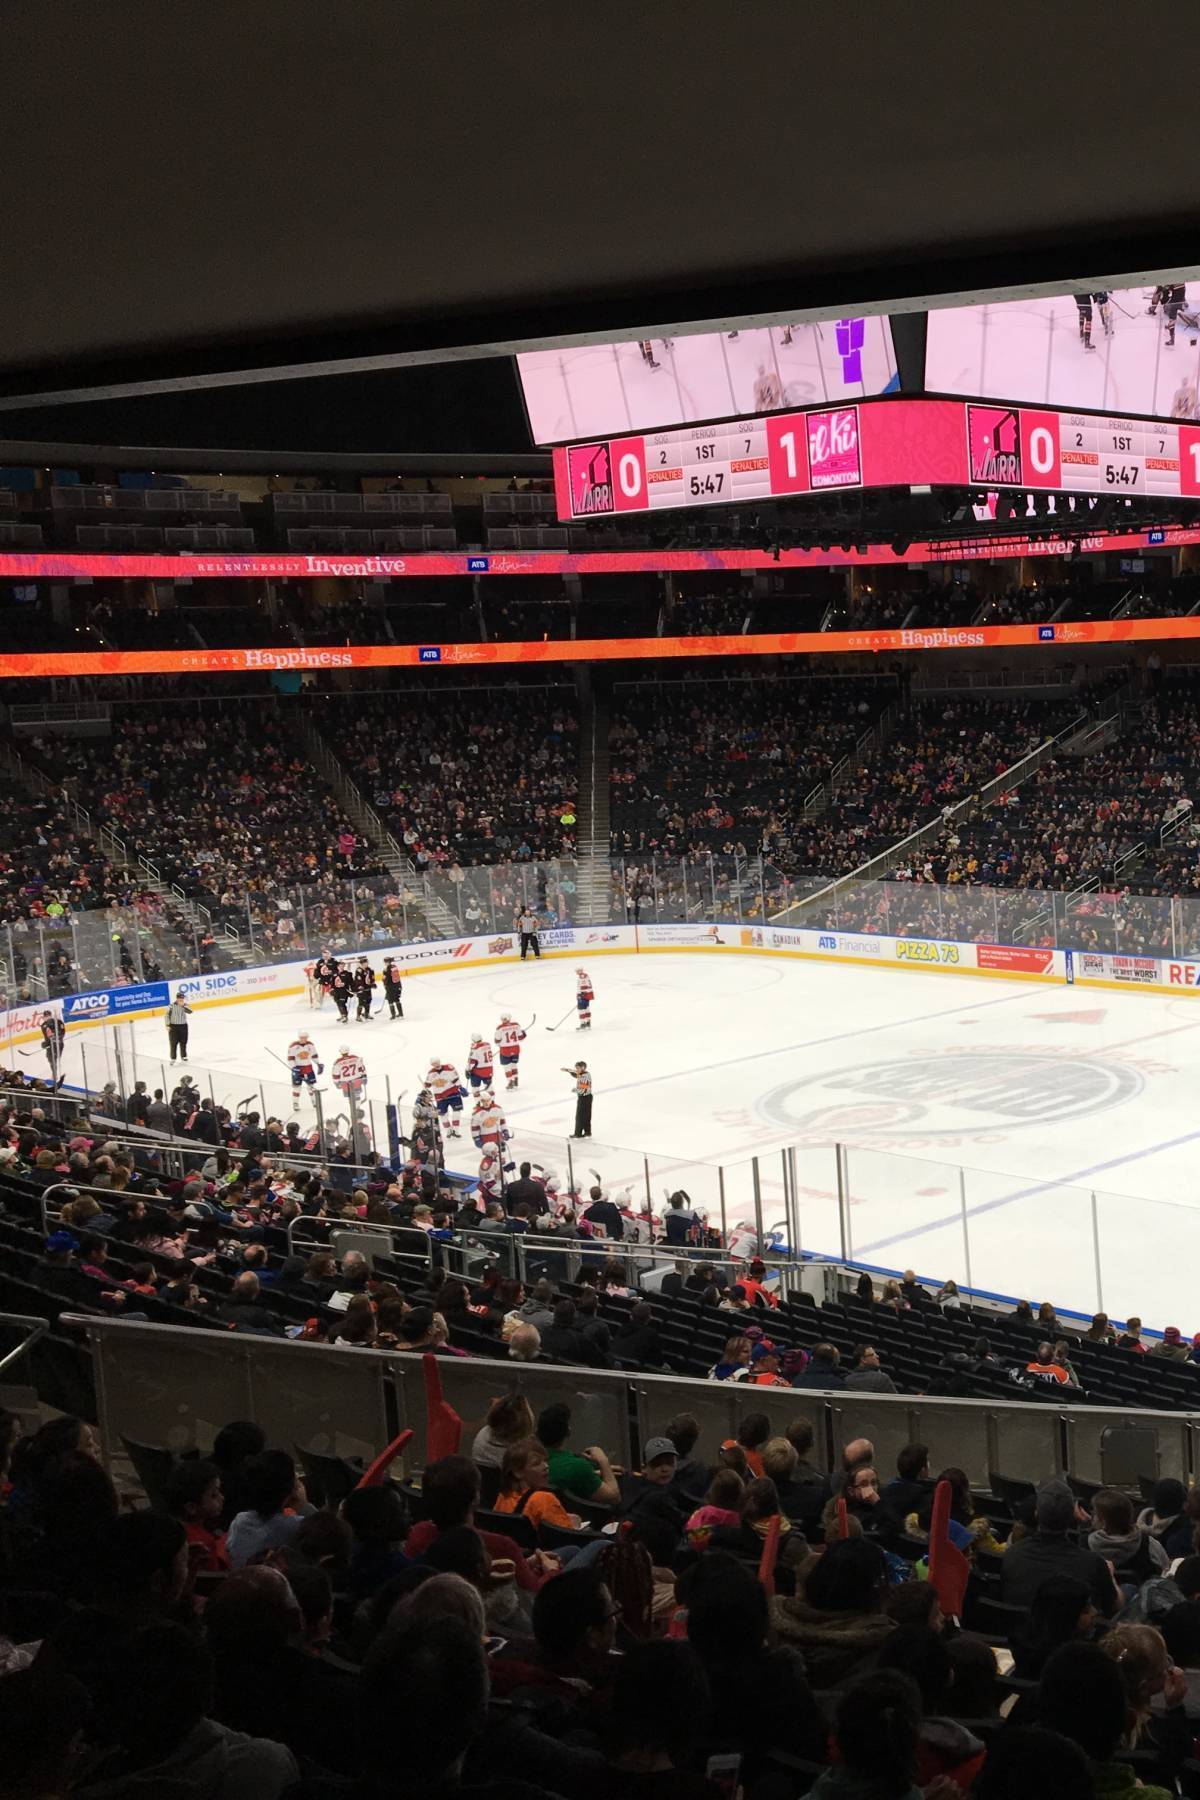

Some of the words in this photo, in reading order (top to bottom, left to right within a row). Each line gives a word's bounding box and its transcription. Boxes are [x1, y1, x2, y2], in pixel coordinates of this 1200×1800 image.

[739, 423, 754, 433] SOG
[1070, 417, 1085, 427] SOG
[654, 434, 668, 445] SOG
[744, 439, 751, 454] 7
[1076, 433, 1083, 447] 2
[1112, 436, 1132, 451] 1ST
[695, 444, 716, 460] 1ST
[1030, 427, 1055, 474] 0
[1159, 440, 1165, 454] 7
[660, 451, 667, 465] 2
[780, 431, 797, 478] 1
[1062, 453, 1098, 465] PENALTIES
[731, 458, 768, 473] PENALTIES
[1146, 458, 1179, 471] PENALTIES
[619, 453, 642, 497] 0
[648, 469, 683, 483] PENALTIES
[811, 471, 859, 487] EDMONTON
[1105, 465, 1139, 486] 5:47
[690, 473, 724, 496] 5:47
[1151, 532, 1162, 541] ATB
[198, 563, 300, 572] RELENTLESSLY
[305, 556, 406, 576] Inventive
[471, 561, 485, 569] ATB
[848, 637, 897, 645] CREATE
[900, 628, 984, 648] Happiness
[1041, 630, 1053, 638] ATB
[182, 657, 239, 665] CREATE
[244, 648, 352, 669] Happiness
[423, 651, 437, 659] ATB
[773, 934, 801, 945] CANADIAN
[818, 936, 837, 949] ATB
[839, 937, 881, 954] Financial
[896, 940, 940, 962] PIZZA
[941, 944, 960, 964] 73
[1134, 969, 1157, 979] WORST
[178, 981, 200, 994] ON
[184, 987, 238, 1001] ESTORATION
[70, 994, 110, 1013] ATCO
[504, 1031, 517, 1043] 14
[342, 1064, 357, 1077] 27
